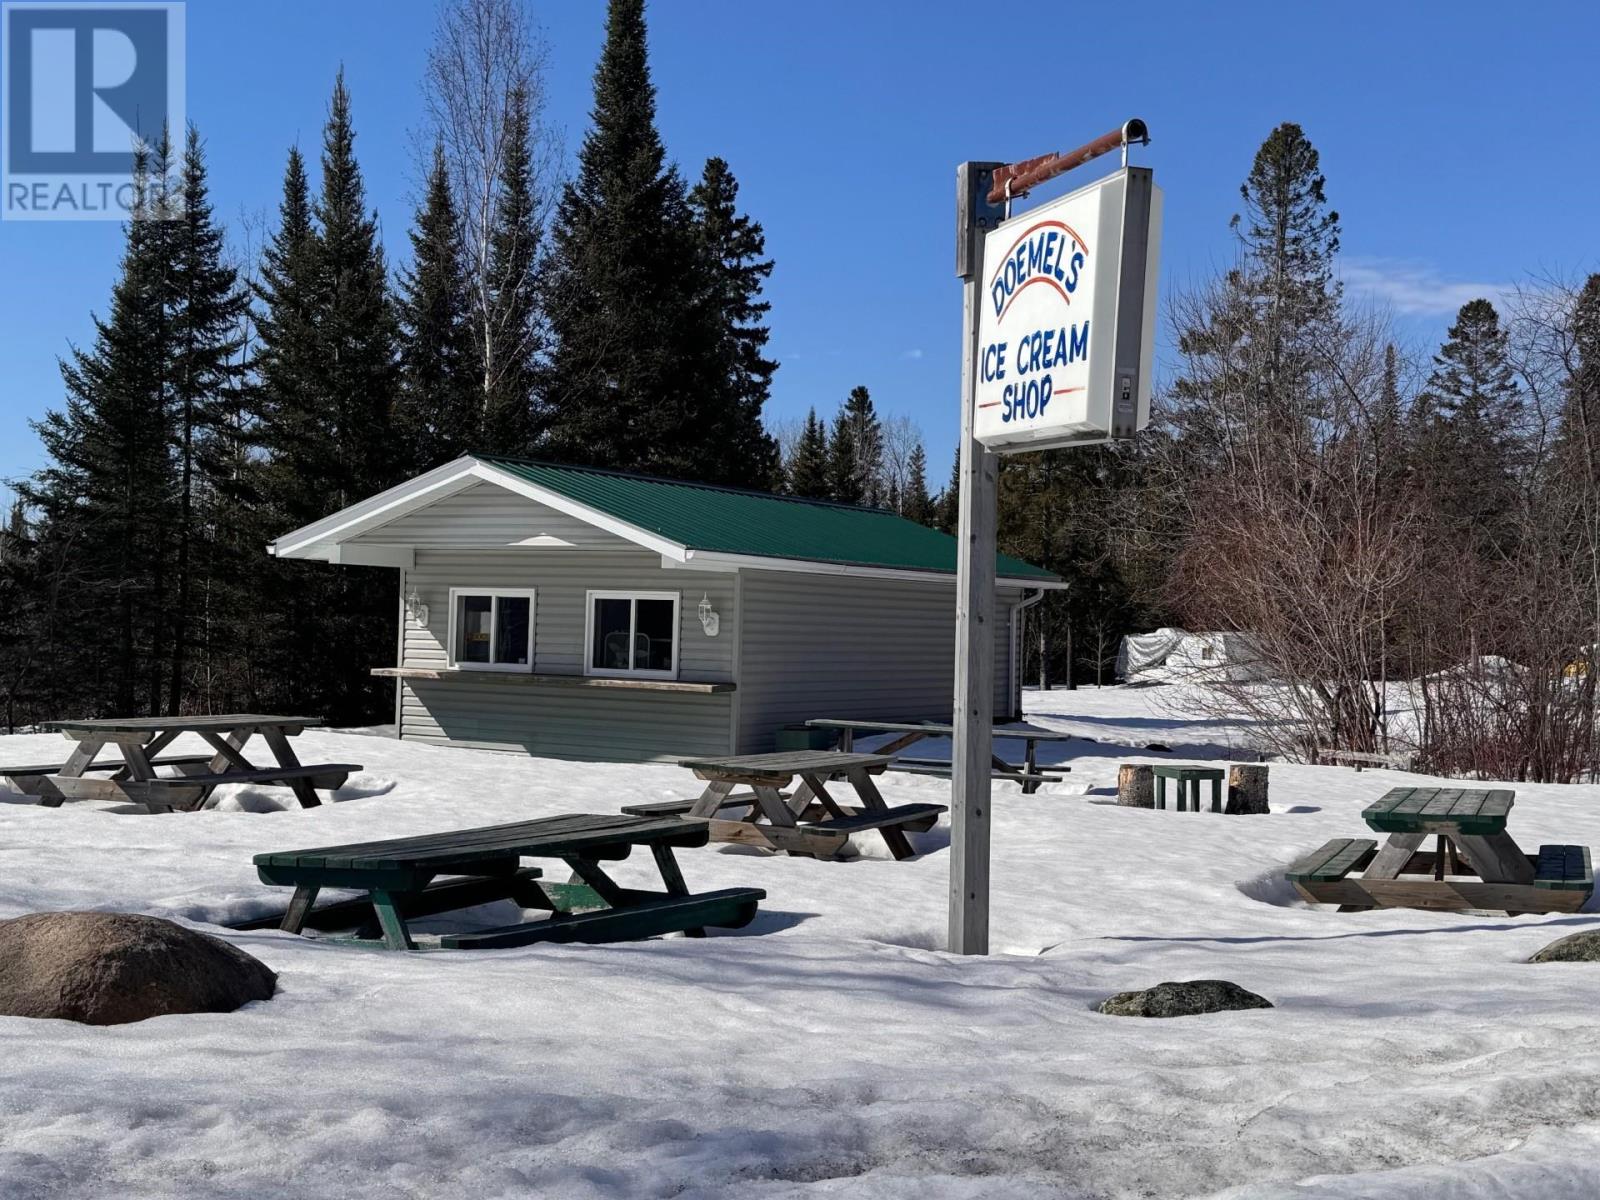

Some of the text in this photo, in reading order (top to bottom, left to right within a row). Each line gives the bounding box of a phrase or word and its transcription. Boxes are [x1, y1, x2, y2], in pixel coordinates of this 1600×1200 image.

[991, 231, 1084, 317] DOEMEL'S
[980, 320, 1090, 384] ICE CREAM
[1001, 374, 1052, 423] SHOP
